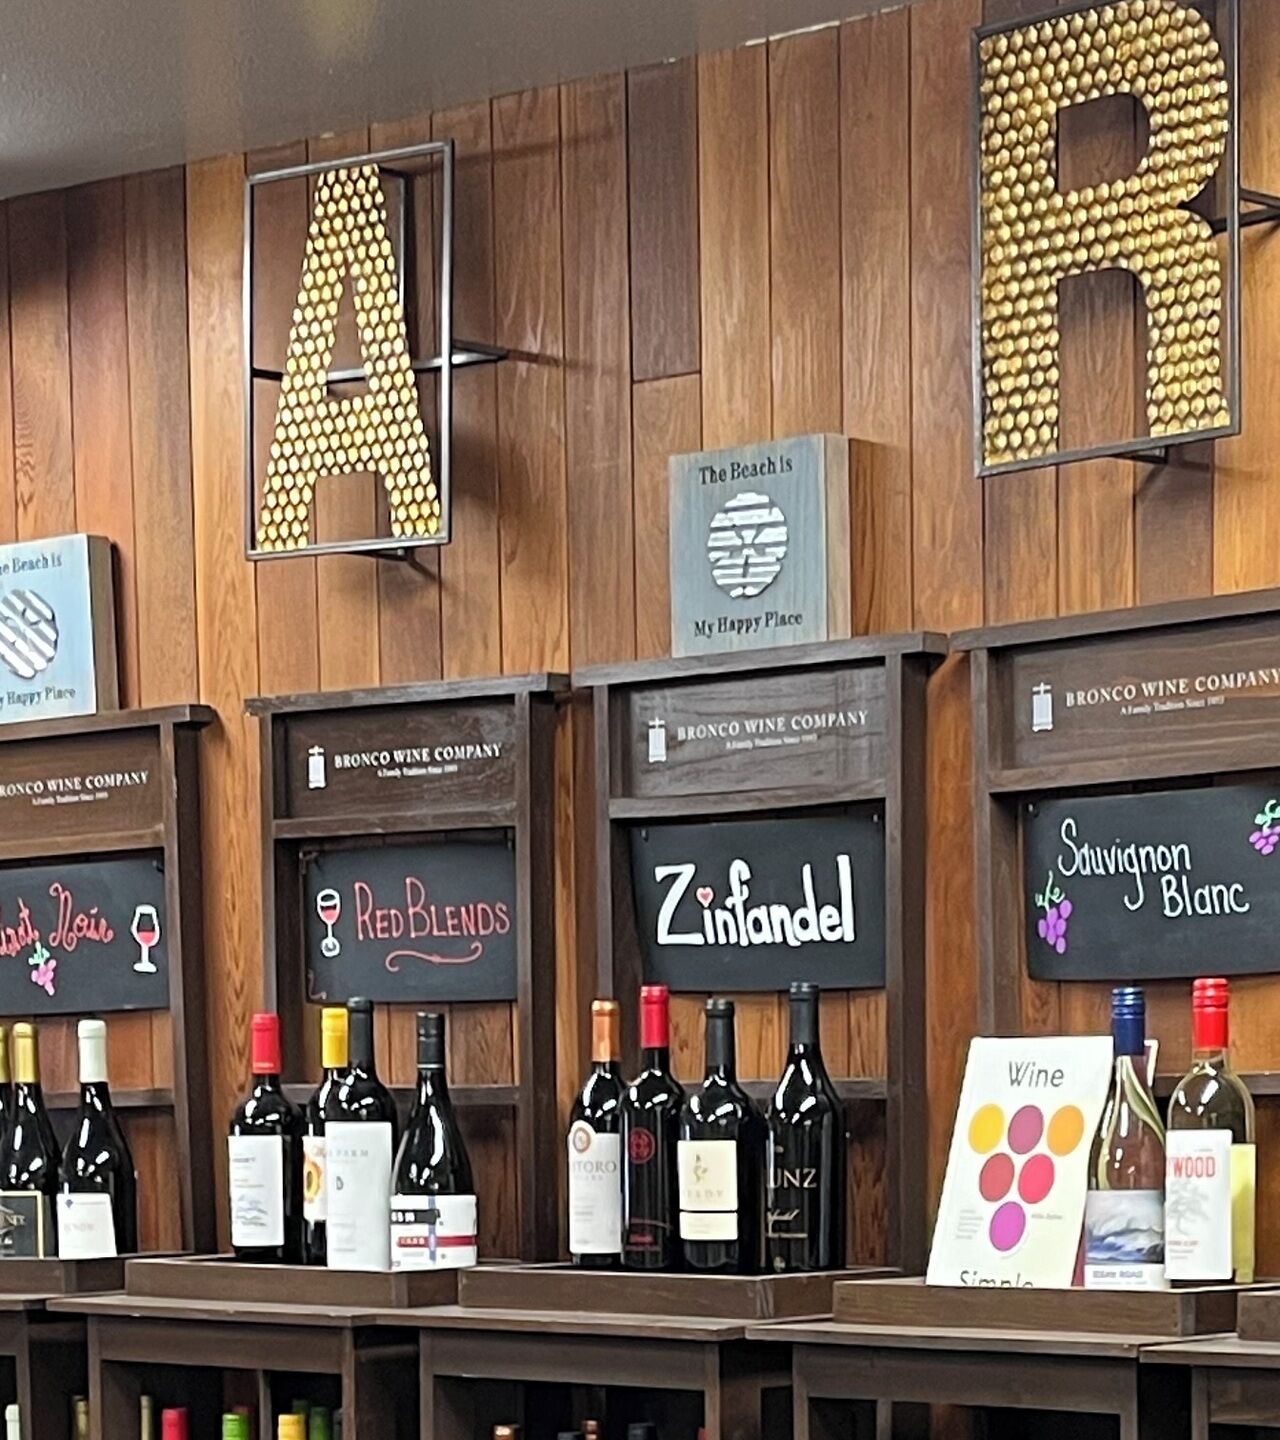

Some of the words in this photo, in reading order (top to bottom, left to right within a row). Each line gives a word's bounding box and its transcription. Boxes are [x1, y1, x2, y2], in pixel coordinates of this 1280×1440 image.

[253, 162, 444, 553] A
[982, 0, 1232, 461] R
[699, 465, 726, 485] The
[730, 456, 776, 481] Beach
[12, 554, 48, 574] Beach
[694, 621, 714, 639] My
[717, 614, 762, 635] Happy
[765, 611, 803, 628] Place
[6, 689, 41, 706] Happy
[44, 686, 75, 701] Place
[1066, 684, 1136, 708] BRONCO
[1141, 678, 1189, 698] WINE
[677, 721, 740, 741] BRONCO
[743, 717, 786, 734] WINE
[790, 710, 869, 731] COMPANY
[334, 750, 390, 769] BRONCO
[393, 747, 431, 763] WINE
[434, 742, 503, 761] COMPANY
[47, 777, 82, 793] WINE
[85, 771, 148, 789] COMPANY
[1058, 818, 1191, 911] Sauvignon
[654, 854, 855, 947] Zinfandel
[1162, 875, 1250, 919] Blanc
[1007, 1060, 1065, 1088] Wine
